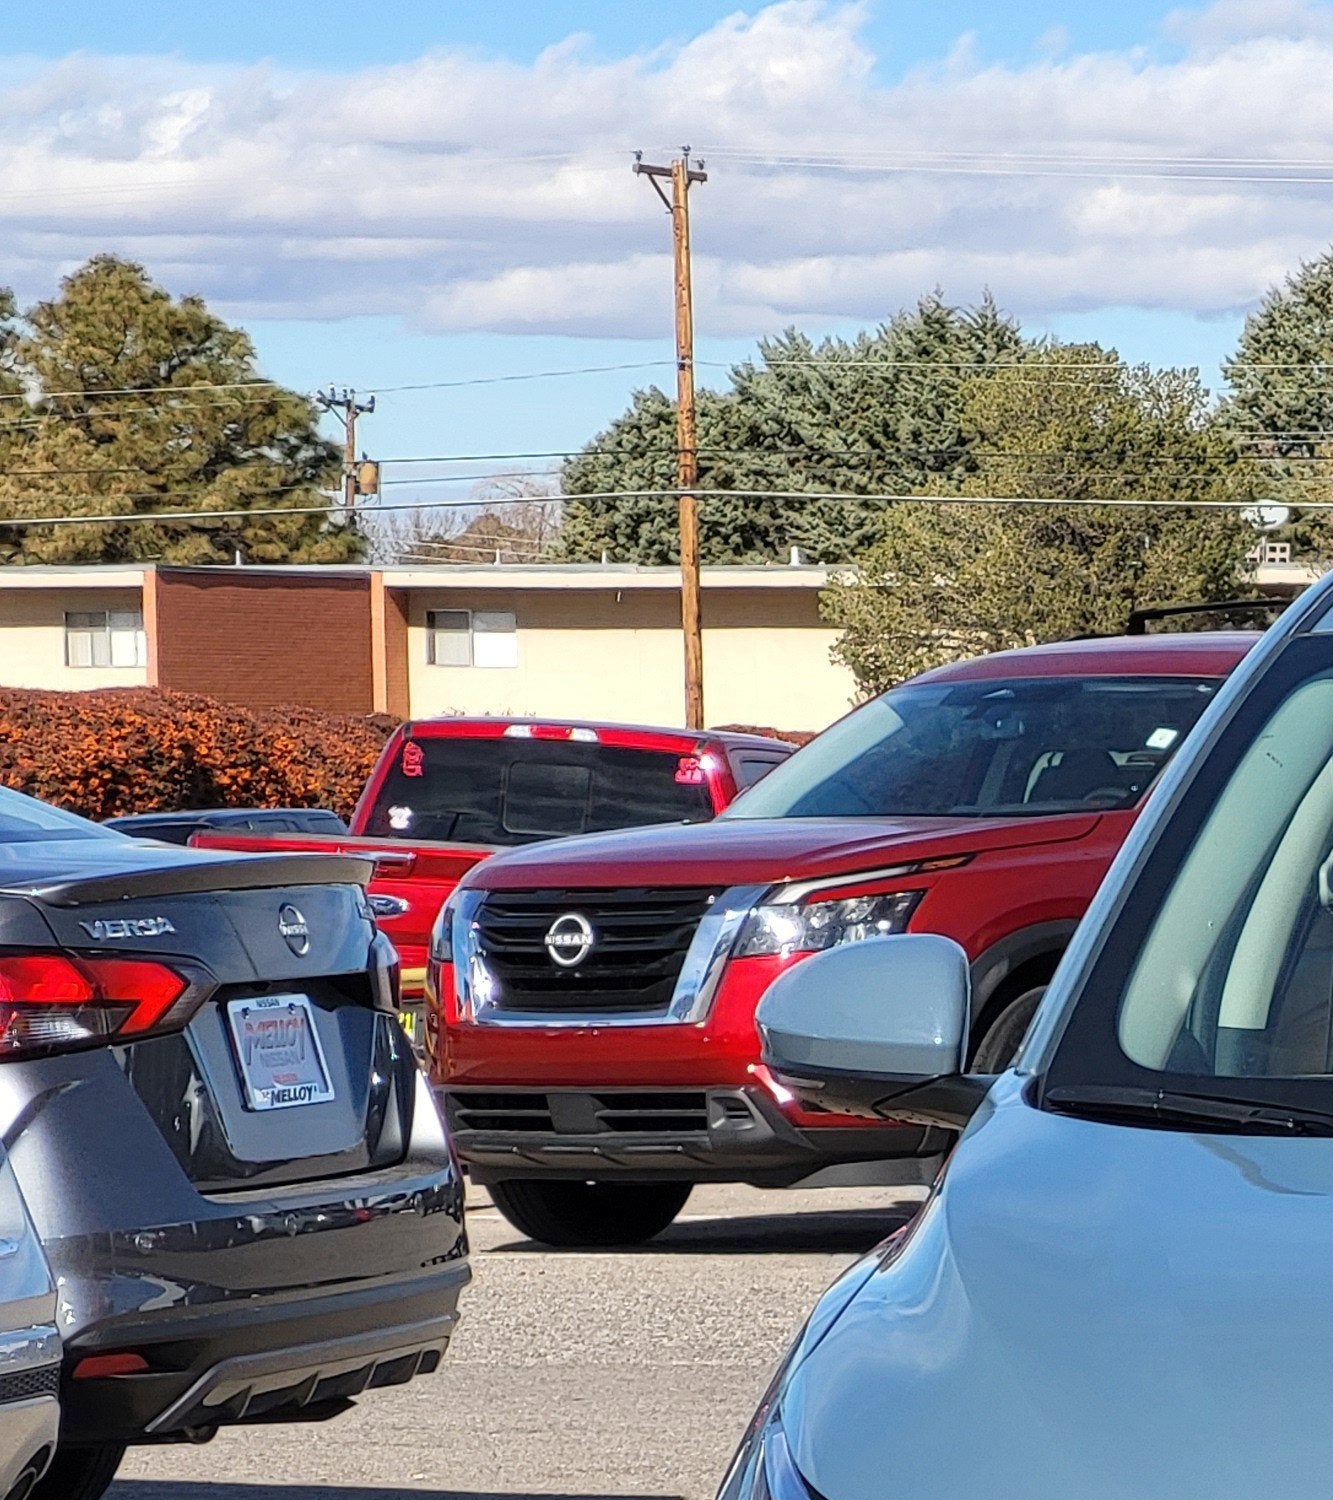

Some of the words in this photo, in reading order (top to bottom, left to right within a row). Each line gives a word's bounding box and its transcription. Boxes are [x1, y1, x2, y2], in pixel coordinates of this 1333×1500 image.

[79, 916, 176, 939] VERSA
[545, 933, 593, 945] NISSAN
[245, 1018, 305, 1066] MELLOY
[271, 1086, 314, 1106] MELLOY
